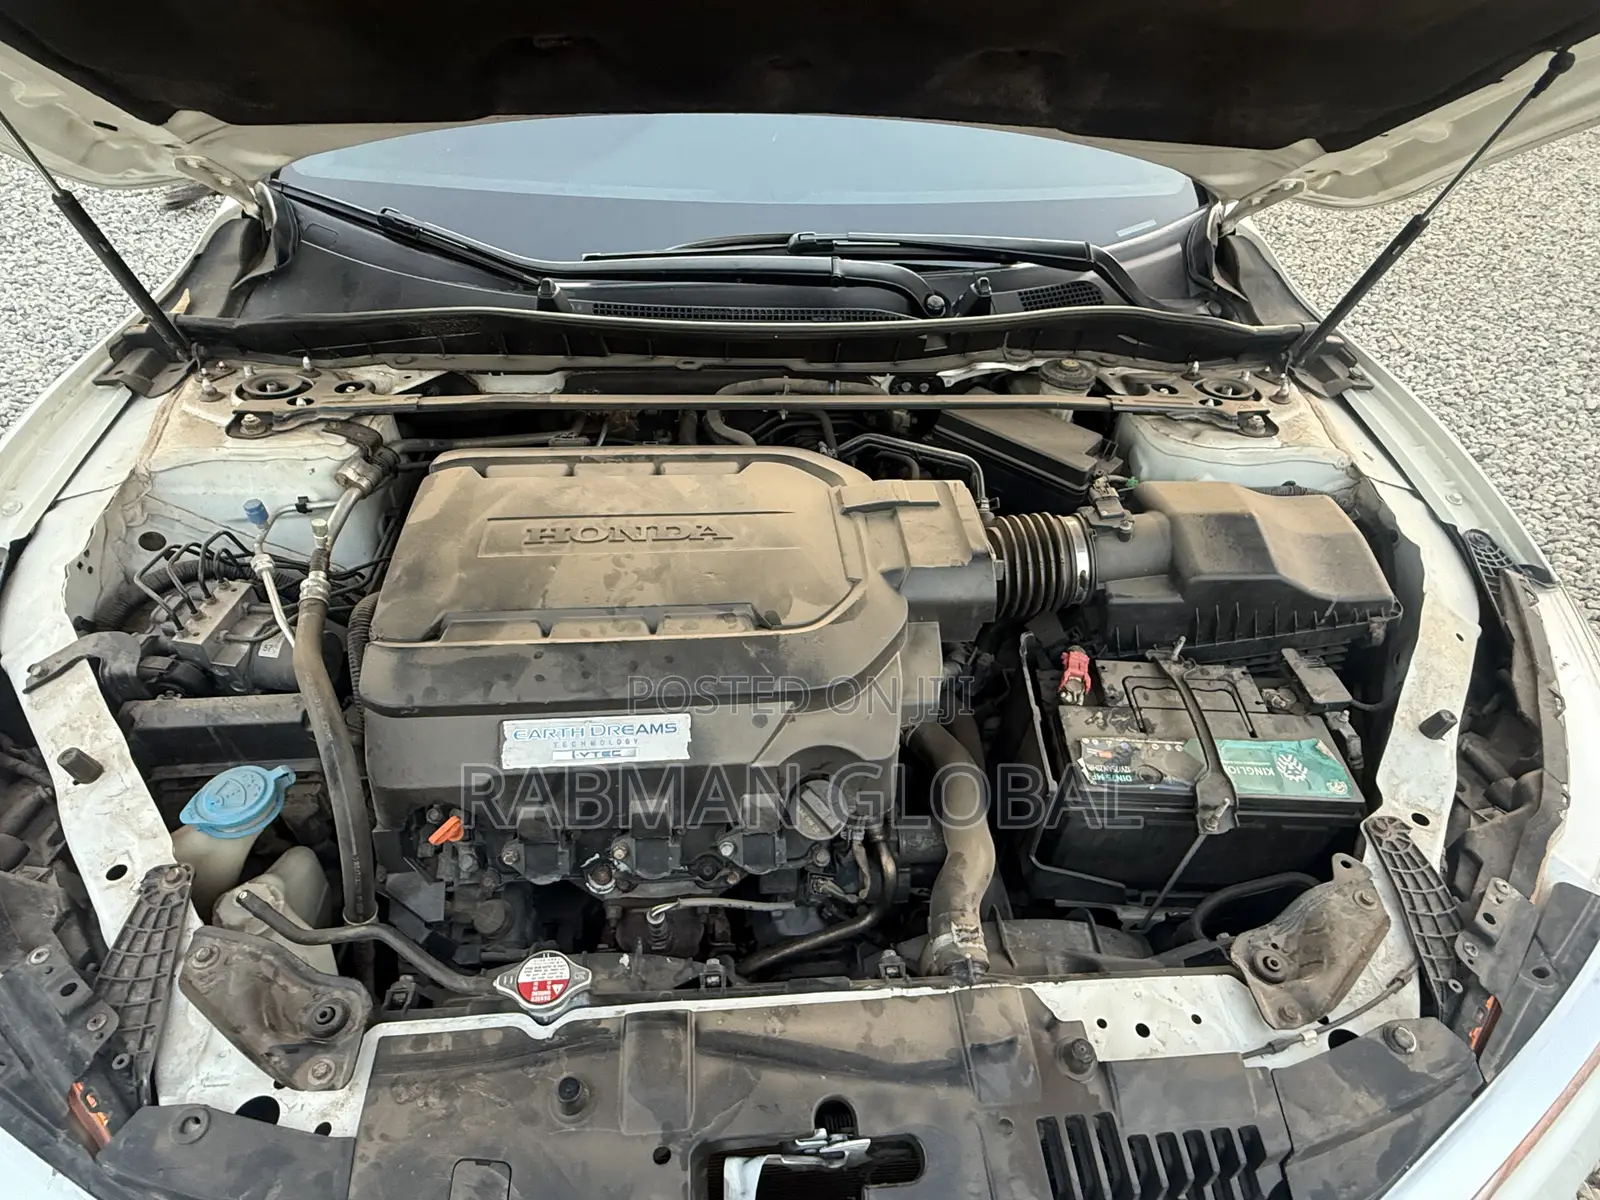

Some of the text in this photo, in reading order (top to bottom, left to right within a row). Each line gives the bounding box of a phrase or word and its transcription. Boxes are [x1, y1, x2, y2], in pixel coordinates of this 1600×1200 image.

[523, 525, 734, 546] HONDA
[513, 722, 678, 740] EARTH DREAMS
[553, 738, 639, 748] TECHNOLOGY
